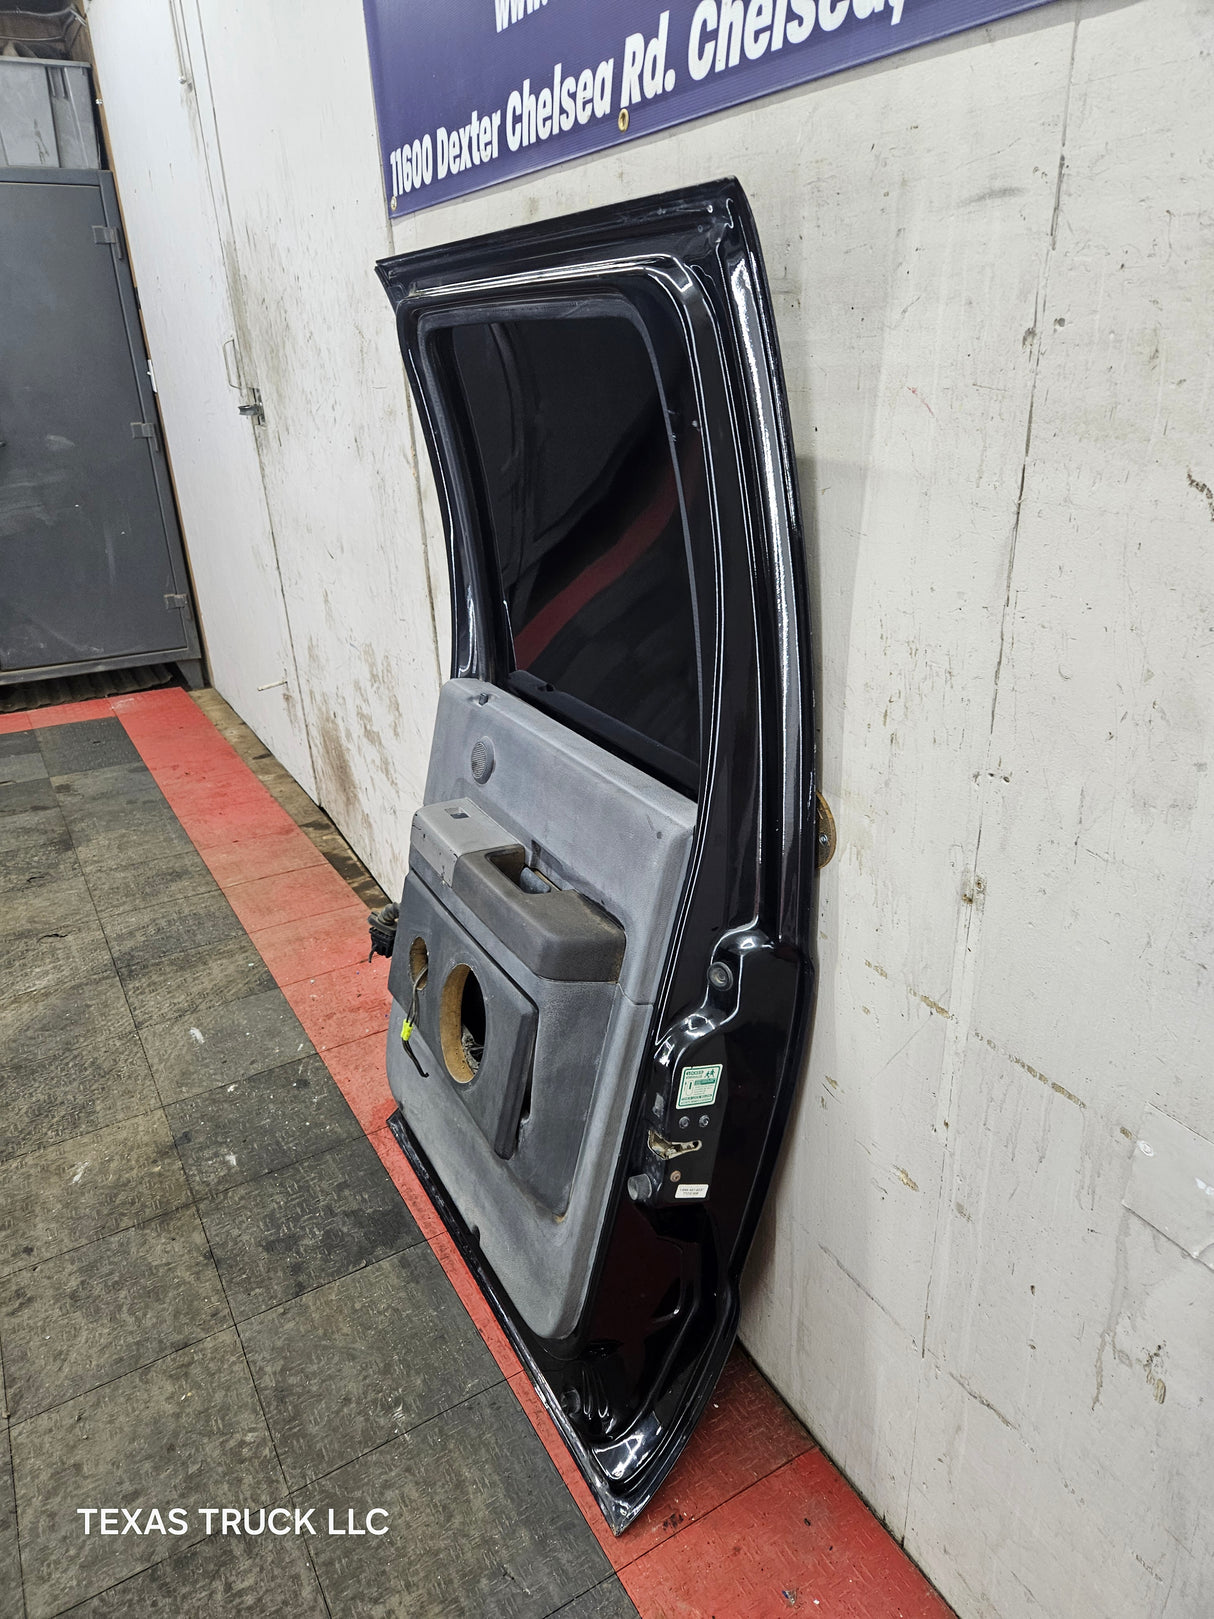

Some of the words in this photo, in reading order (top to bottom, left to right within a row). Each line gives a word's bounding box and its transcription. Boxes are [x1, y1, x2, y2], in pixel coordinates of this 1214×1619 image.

[390, 134, 433, 197] 11600
[436, 109, 501, 180] Dexter
[506, 58, 614, 151] Chelsea
[620, 10, 676, 108] Rd.
